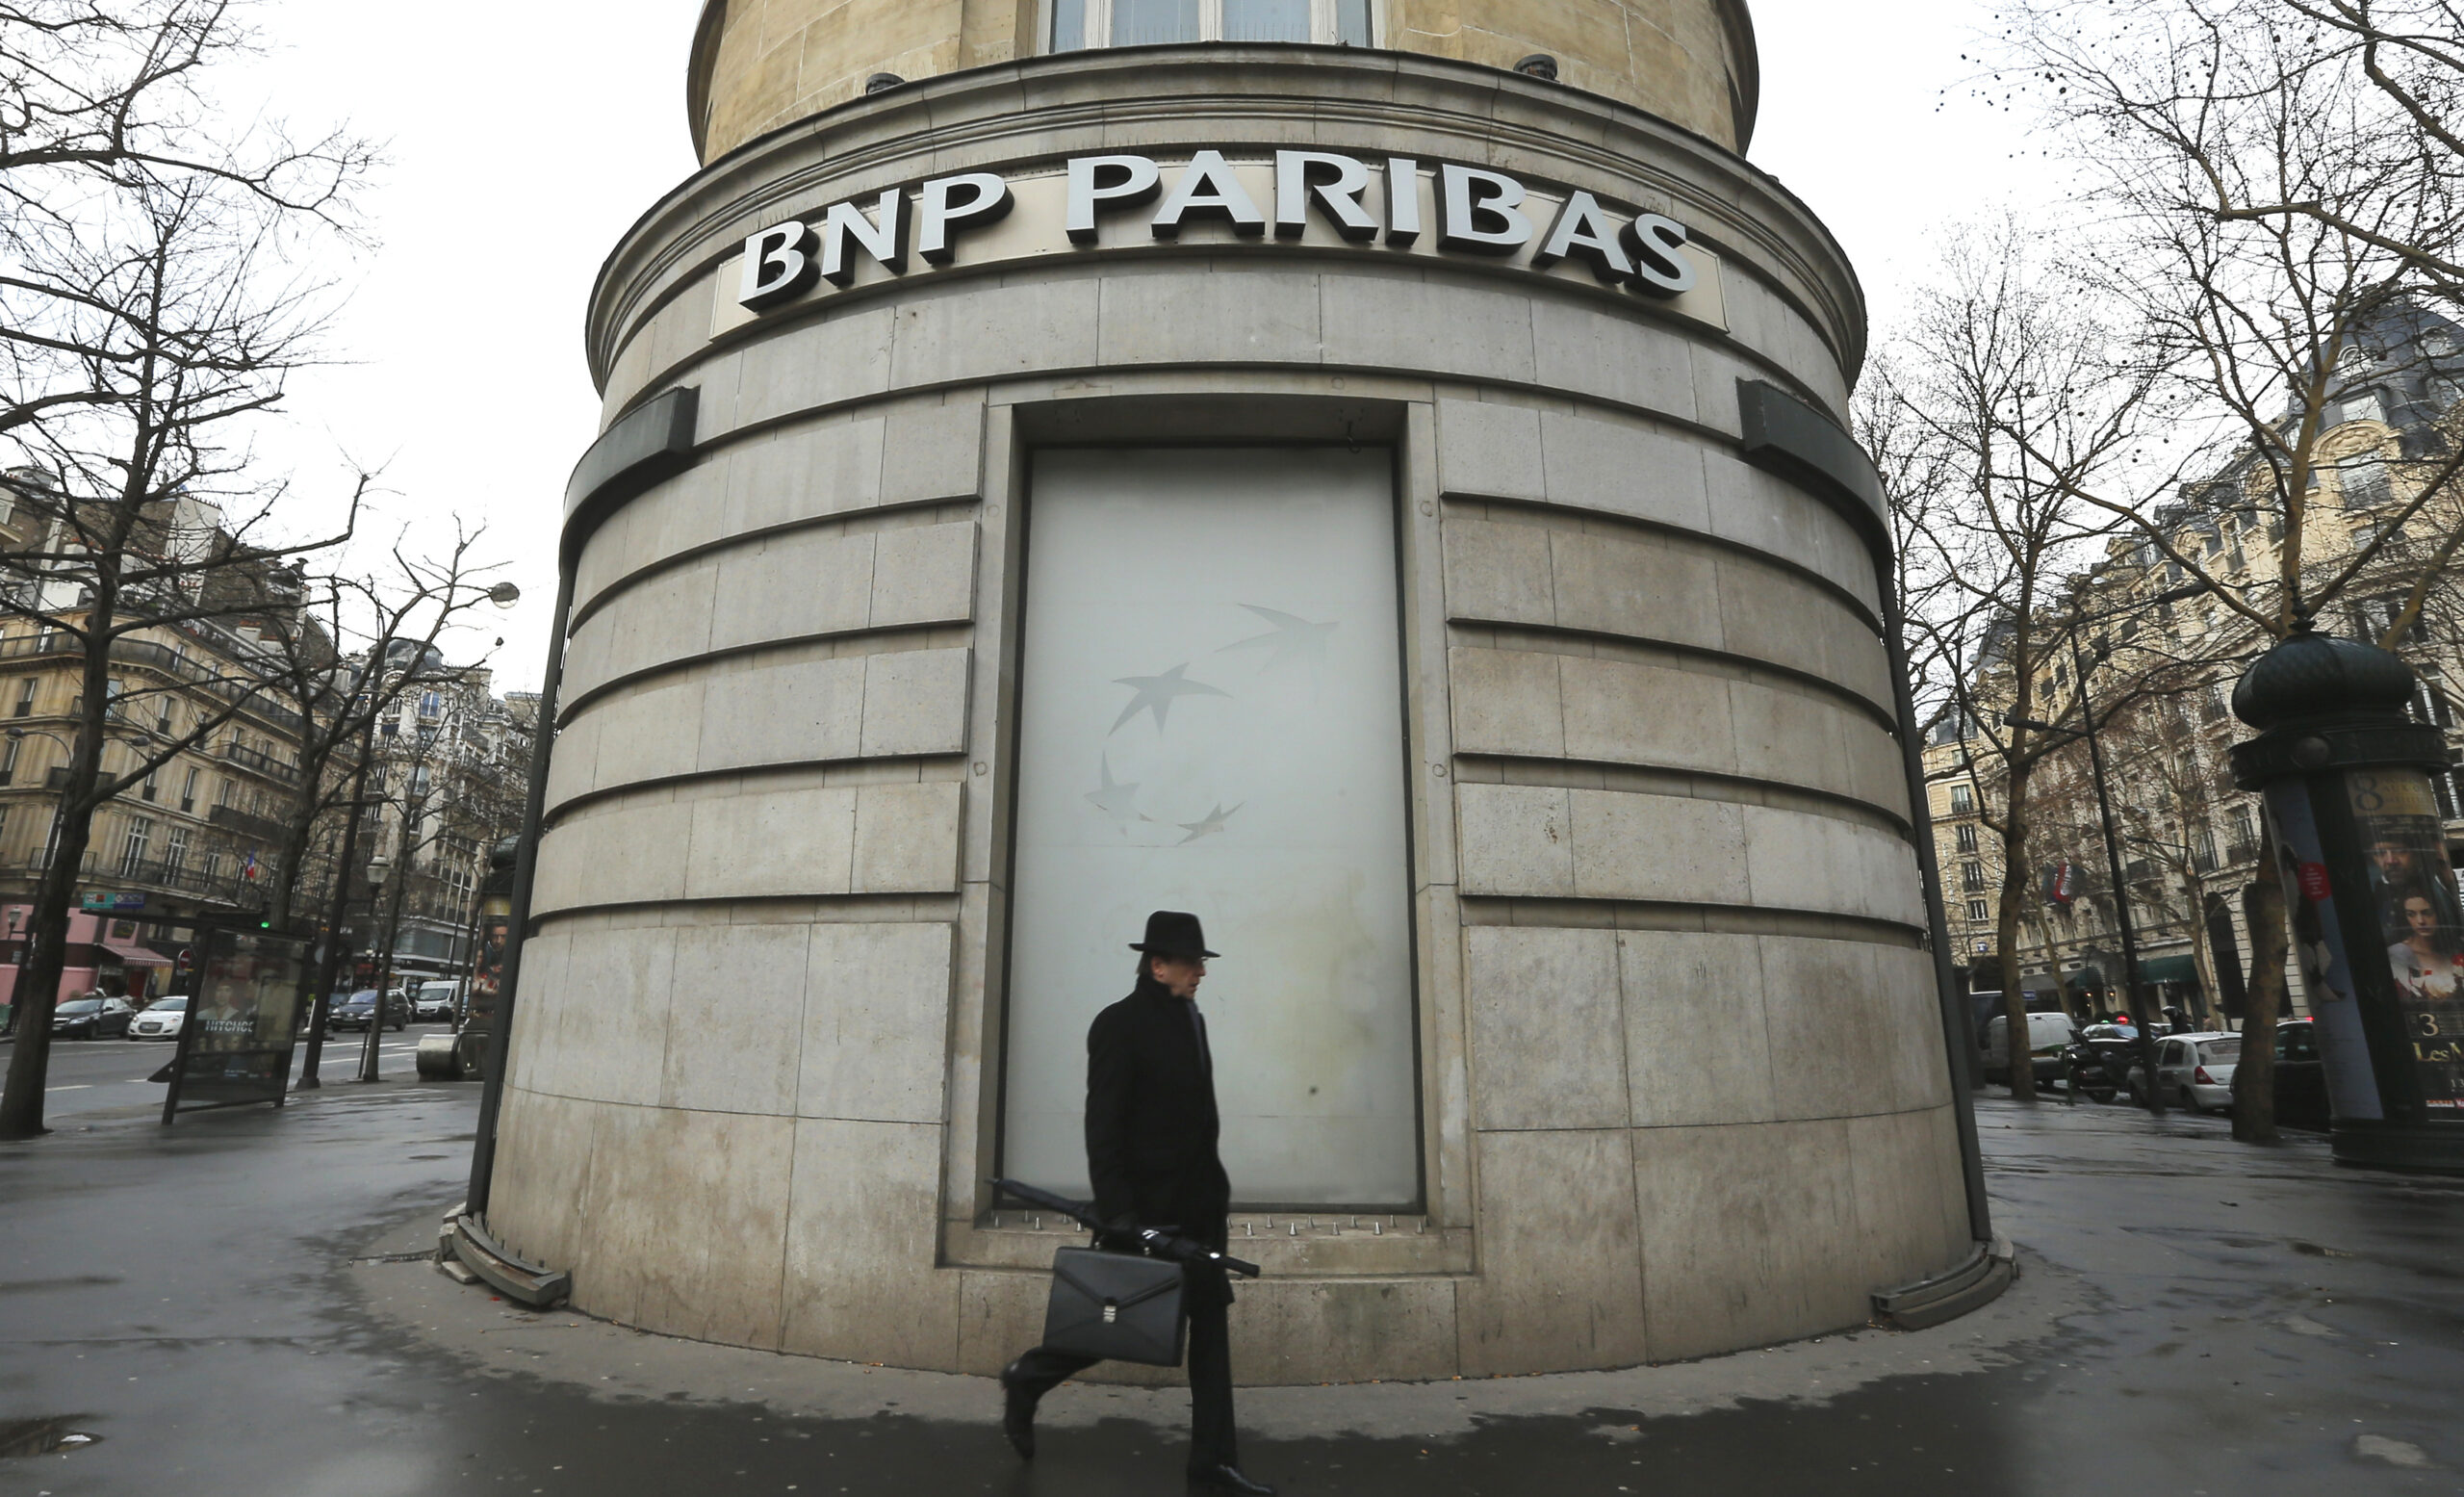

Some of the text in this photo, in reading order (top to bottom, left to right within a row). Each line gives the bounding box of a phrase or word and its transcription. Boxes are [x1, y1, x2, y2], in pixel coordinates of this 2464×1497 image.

[737, 149, 1699, 312] BNP PARIBAS
[2355, 774, 2384, 811] 8
[2418, 1013, 2440, 1037] 3
